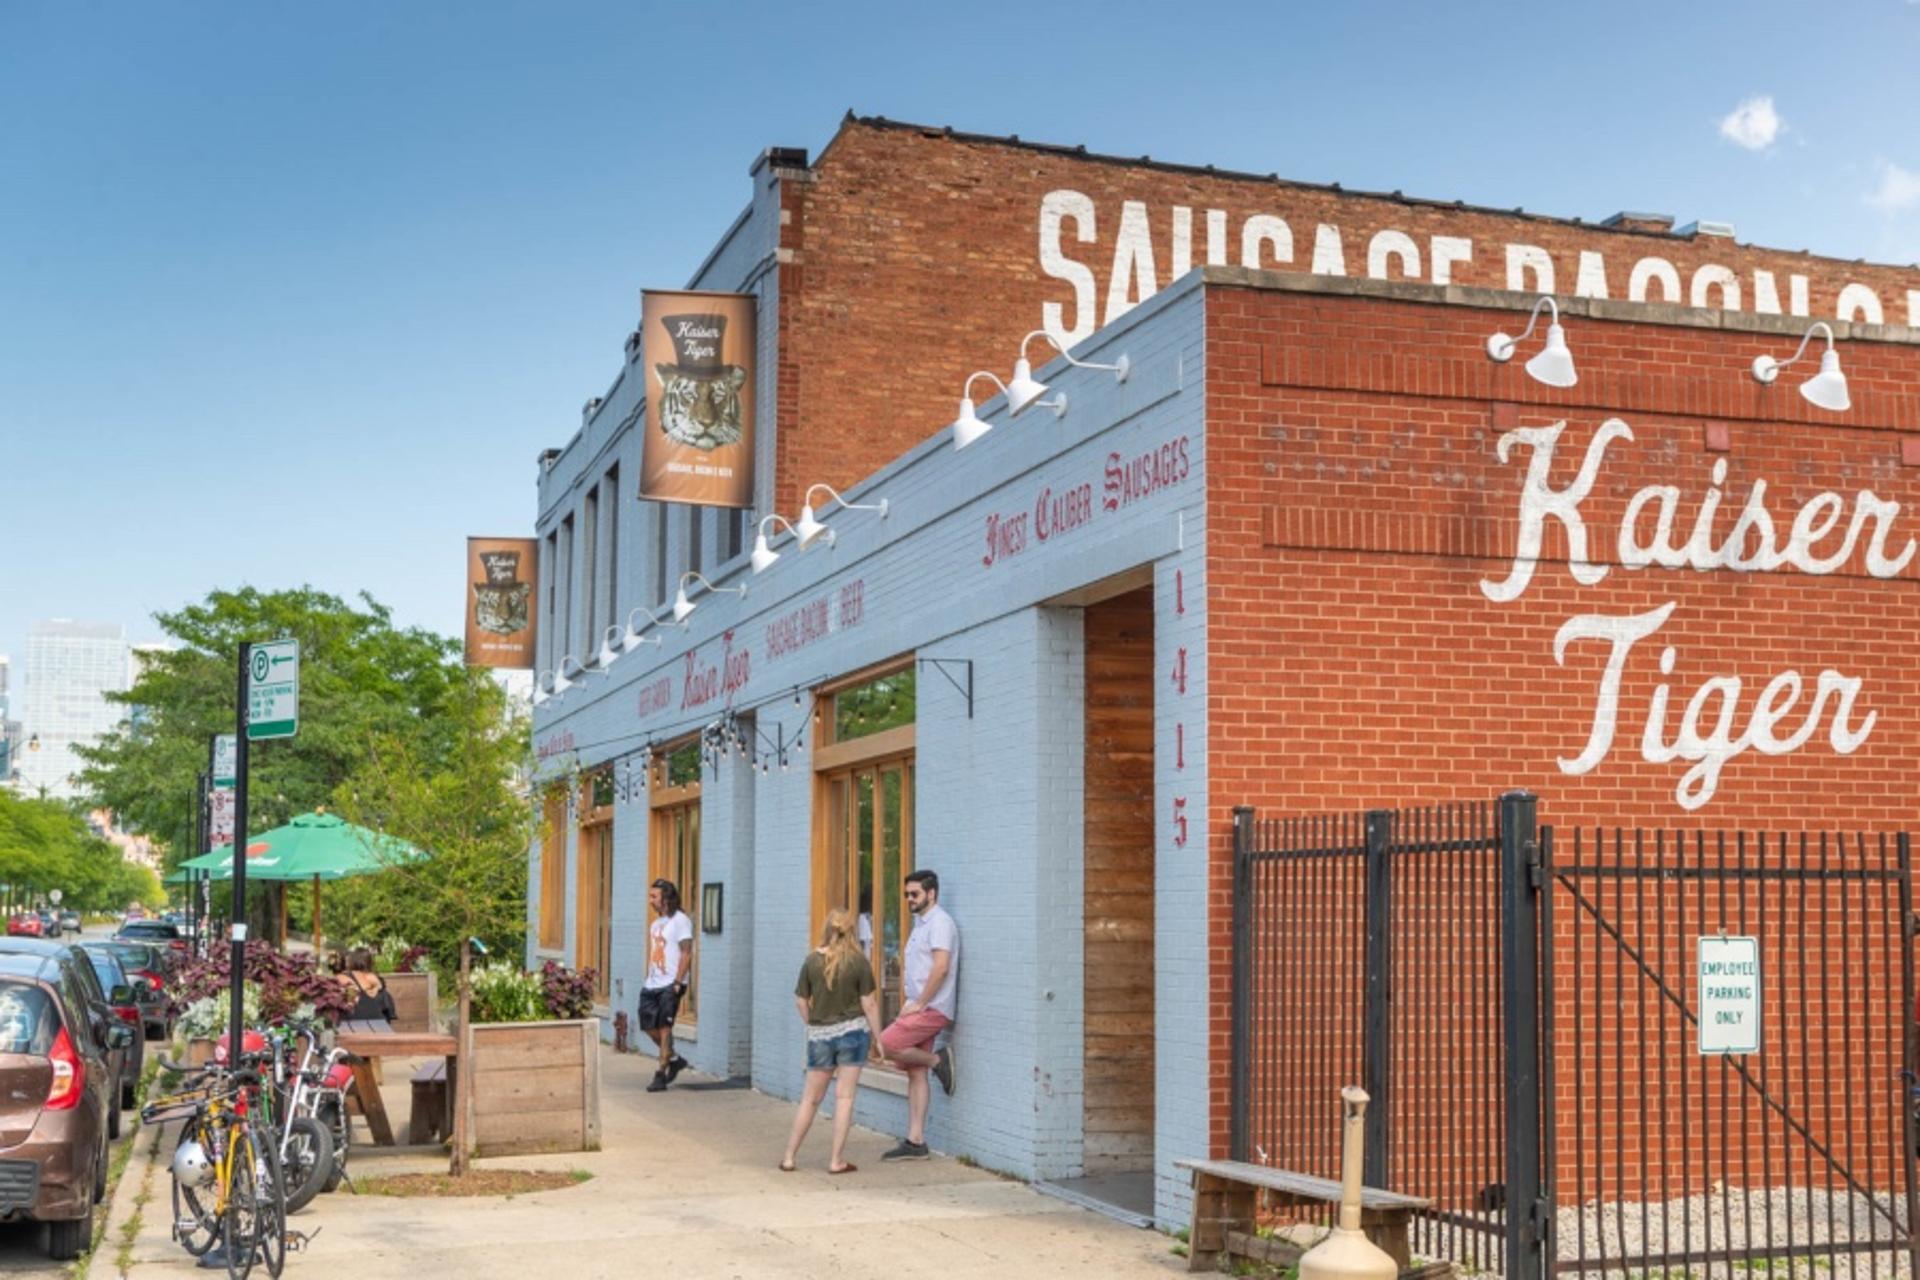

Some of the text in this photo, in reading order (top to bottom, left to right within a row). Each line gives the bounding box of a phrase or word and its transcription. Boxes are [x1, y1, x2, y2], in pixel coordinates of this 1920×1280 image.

[675, 321, 720, 339] Kaiser
[683, 339, 716, 361] Tiger
[1035, 483, 1092, 543] CALIBER
[1102, 435, 1190, 512] SAUSAGES
[1480, 418, 1916, 602] Kaiser
[1553, 601, 1877, 810] Tiger
[1702, 961, 1755, 976] EMPLOYEE
[1707, 987, 1752, 999] PARKING
[1715, 1011, 1743, 1025] ONLY
